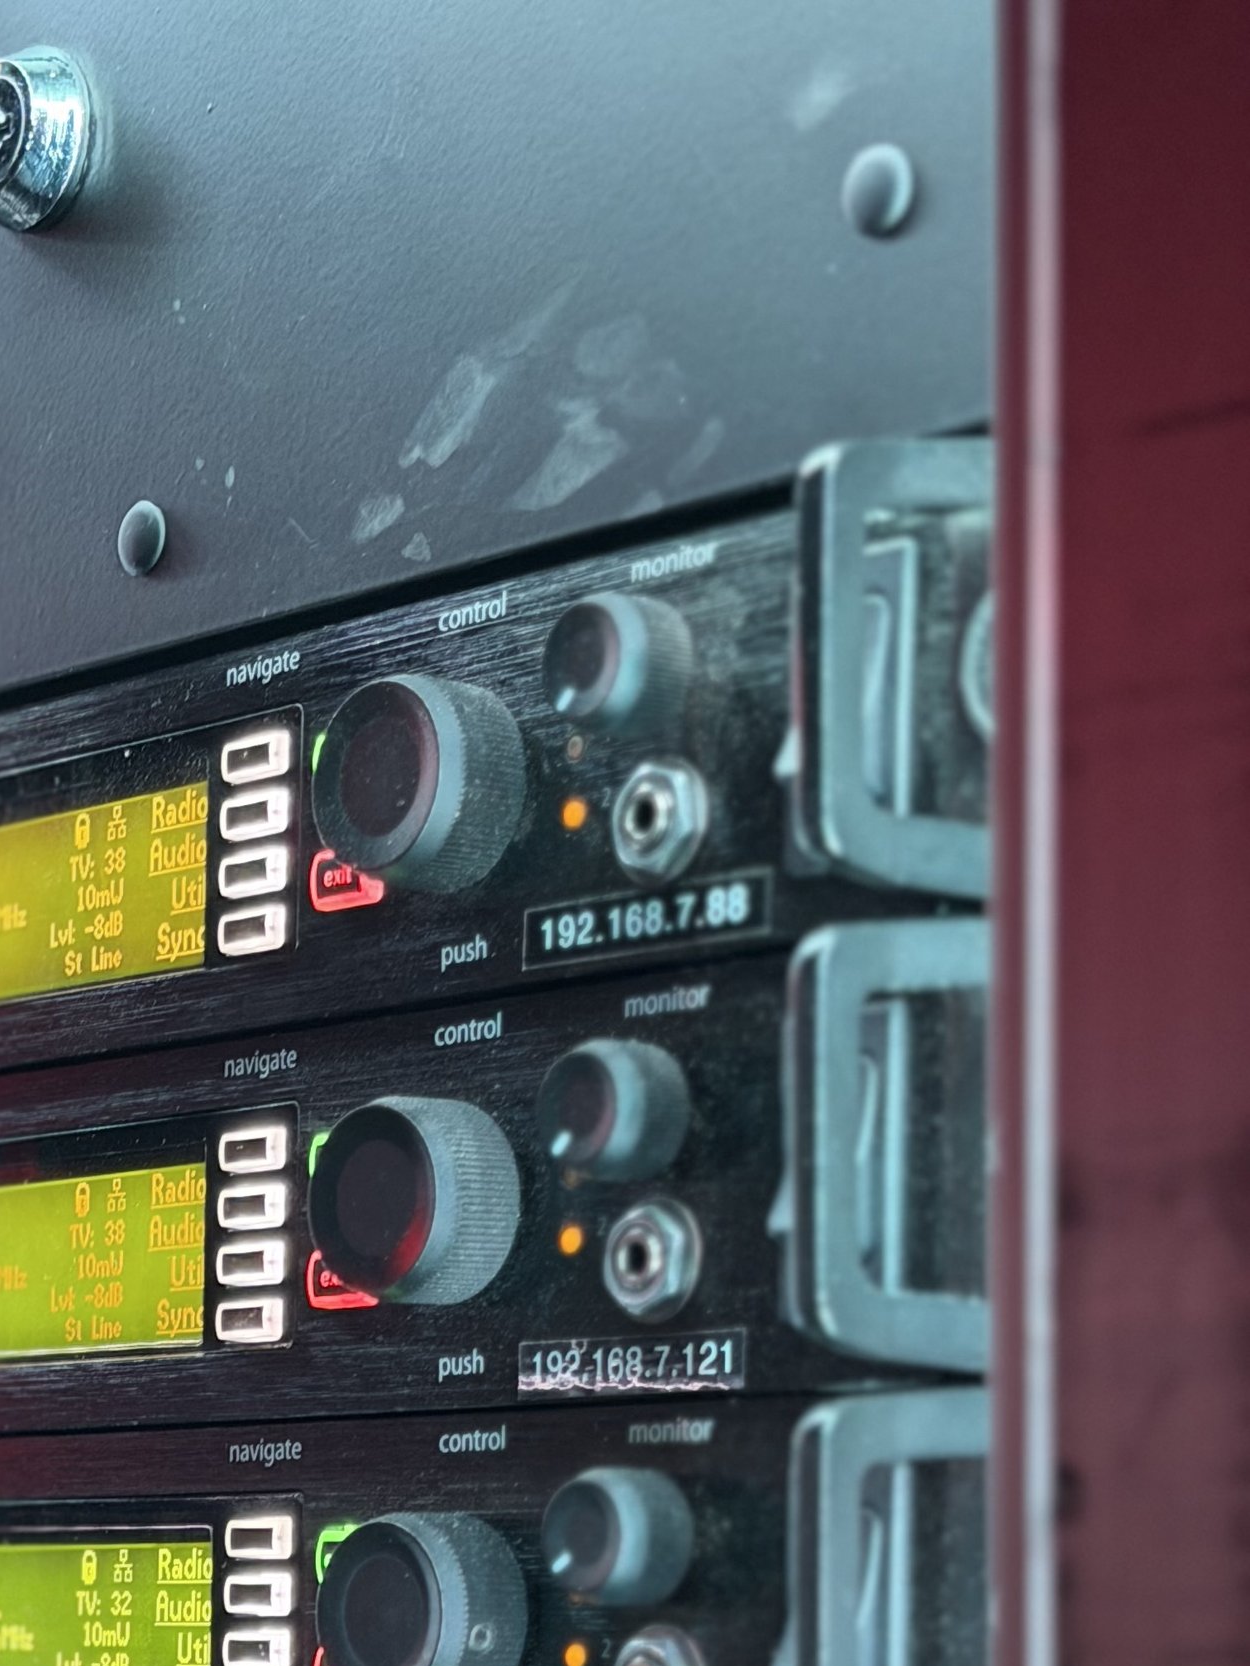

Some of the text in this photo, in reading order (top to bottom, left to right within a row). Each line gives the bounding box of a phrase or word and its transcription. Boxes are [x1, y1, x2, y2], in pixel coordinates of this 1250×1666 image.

[631, 542, 717, 582] monitor
[438, 592, 507, 632] control
[226, 650, 301, 687] navigate
[152, 790, 207, 831] Radio
[70, 848, 126, 882] TV: 38
[150, 835, 206, 874] Audio
[77, 878, 124, 912] 10mW
[84, 910, 123, 940] -8dB
[541, 883, 748, 950] 192.168.7.88
[157, 922, 205, 961] Sync
[440, 934, 487, 972] push
[65, 949, 122, 976] St Line
[624, 984, 710, 1018] monitor
[433, 1012, 502, 1047] control
[224, 1047, 297, 1079] navigate
[152, 1170, 206, 1204] Radio
[70, 1220, 126, 1249] TV: 38
[150, 1212, 204, 1247] Audio
[77, 1250, 123, 1279] 10mW
[84, 1283, 123, 1310] -8dB
[65, 1316, 121, 1342] St Line
[438, 1349, 484, 1381] push
[532, 1338, 733, 1383] 192.168.7.121
[438, 1425, 506, 1453] control
[628, 1417, 715, 1444] monitor
[229, 1438, 302, 1468] navigate
[158, 1548, 213, 1580] Radio
[76, 1591, 132, 1616] TV: 32
[155, 1590, 212, 1624] Audio
[83, 1622, 130, 1648] 10mW
